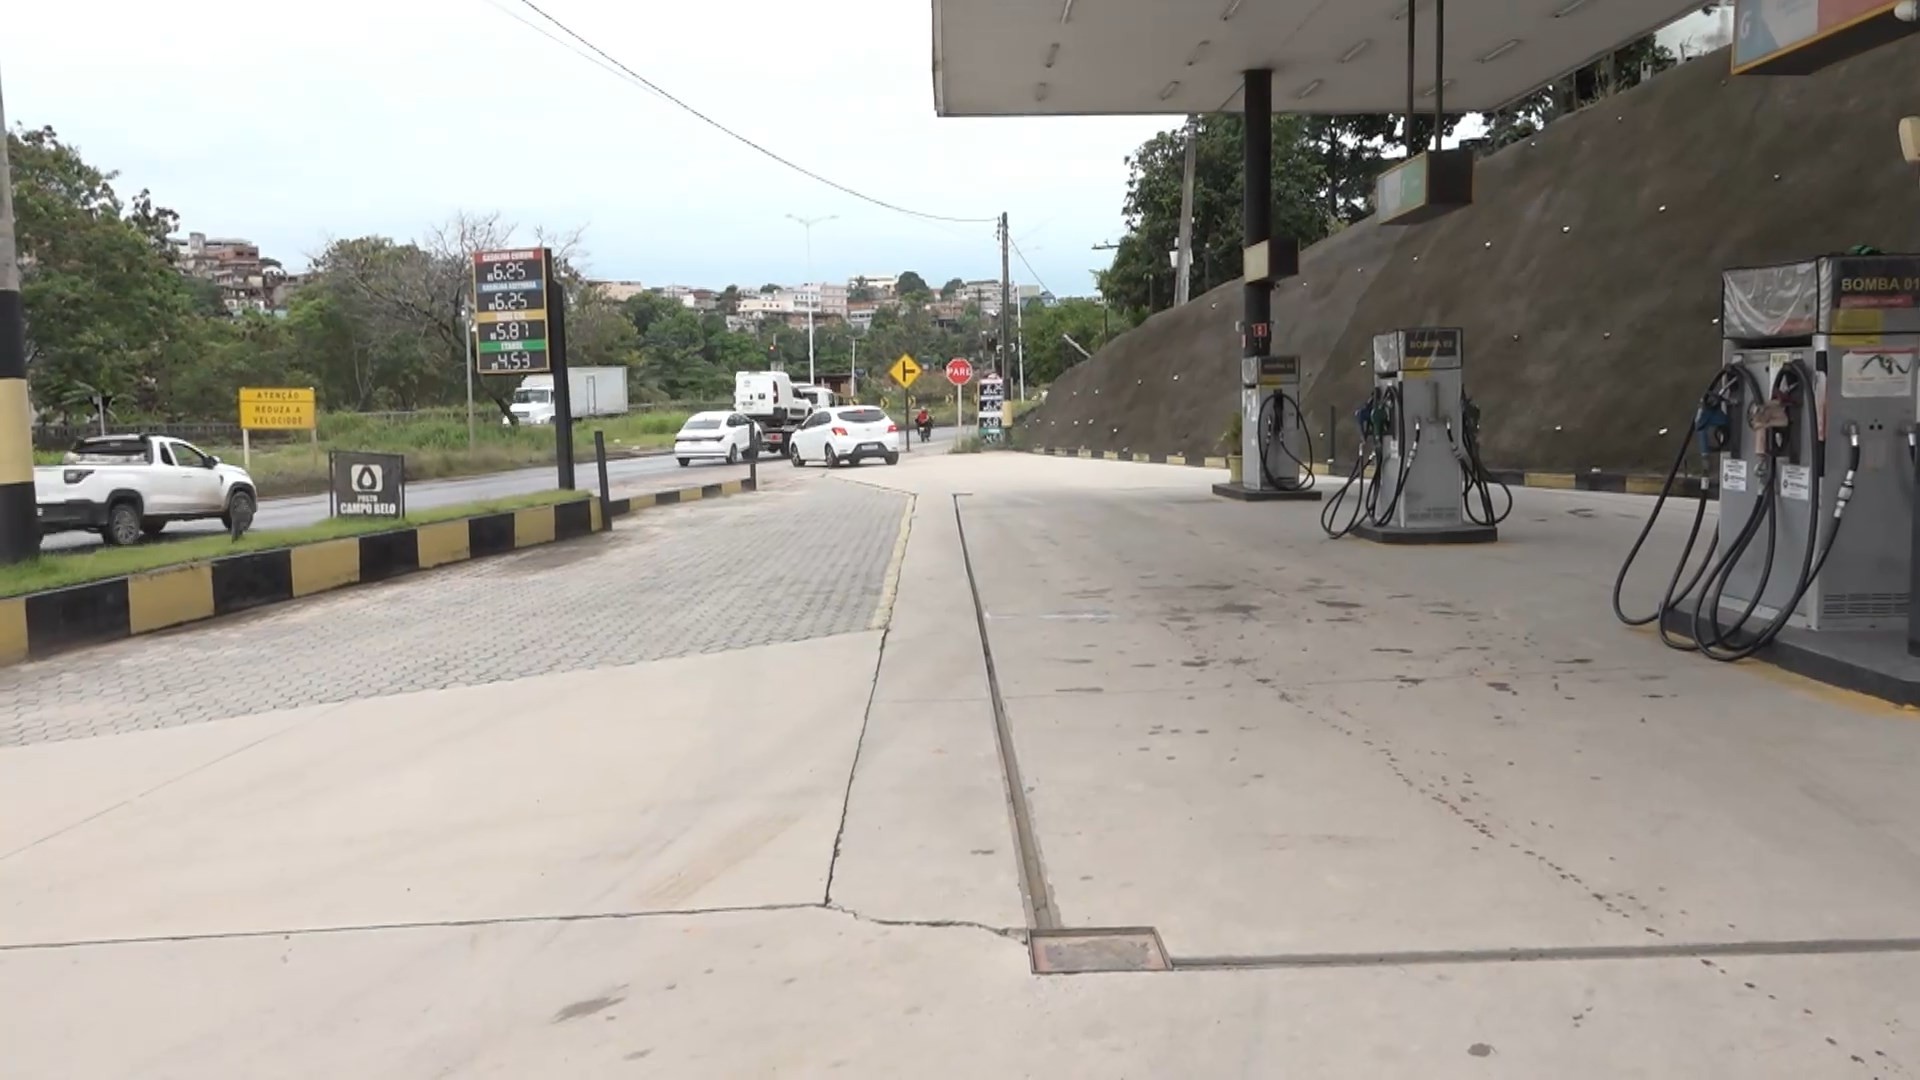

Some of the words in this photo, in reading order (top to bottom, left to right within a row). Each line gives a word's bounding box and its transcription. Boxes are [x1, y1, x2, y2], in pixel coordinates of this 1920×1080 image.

[1841, 278, 1900, 292] BOMBA
[1903, 278, 1920, 291] 01
[254, 406, 291, 414] REDUZA
[357, 494, 378, 502] POSTO
[340, 503, 373, 515] CAMPO
[374, 503, 397, 515] BELO
